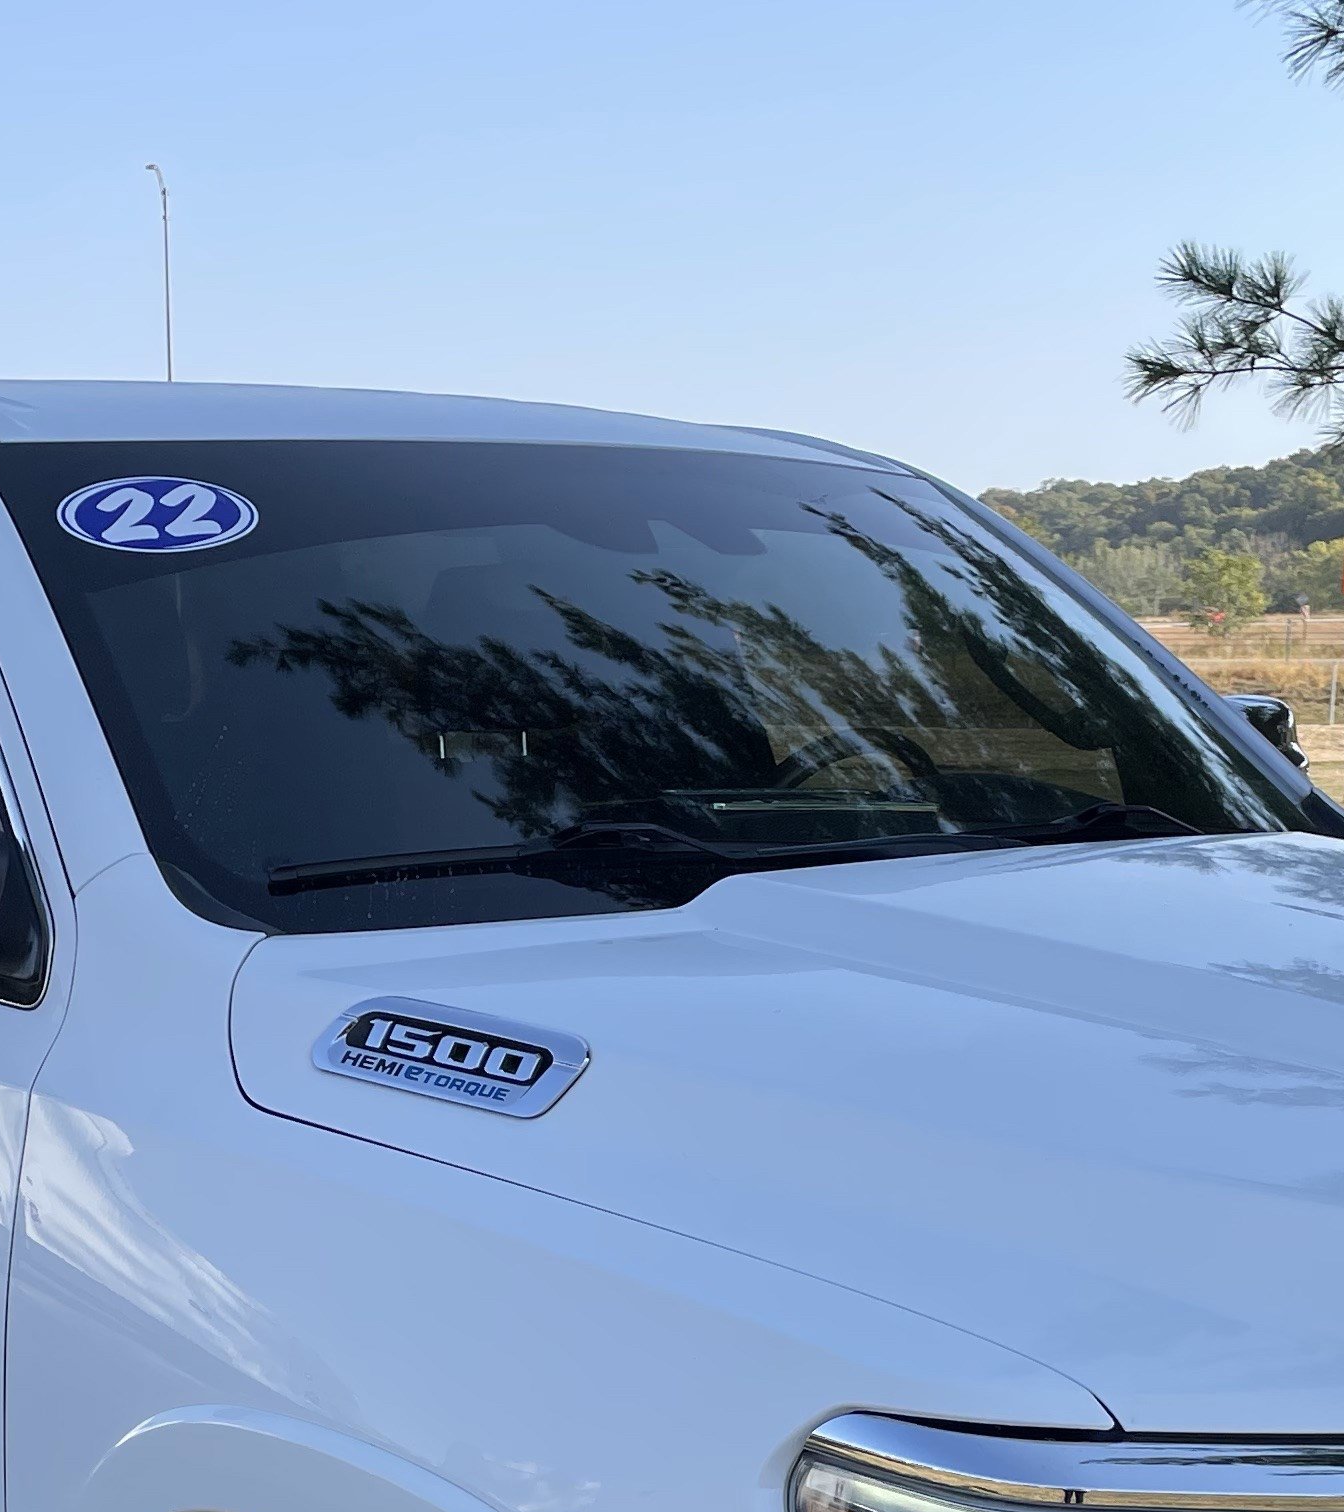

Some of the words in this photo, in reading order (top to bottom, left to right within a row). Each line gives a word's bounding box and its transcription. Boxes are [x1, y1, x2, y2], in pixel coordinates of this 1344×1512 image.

[95, 483, 223, 543] 22
[341, 1050, 405, 1077] HEMI
[404, 1065, 511, 1102] eTORQUE
[364, 1017, 542, 1083] 1500
